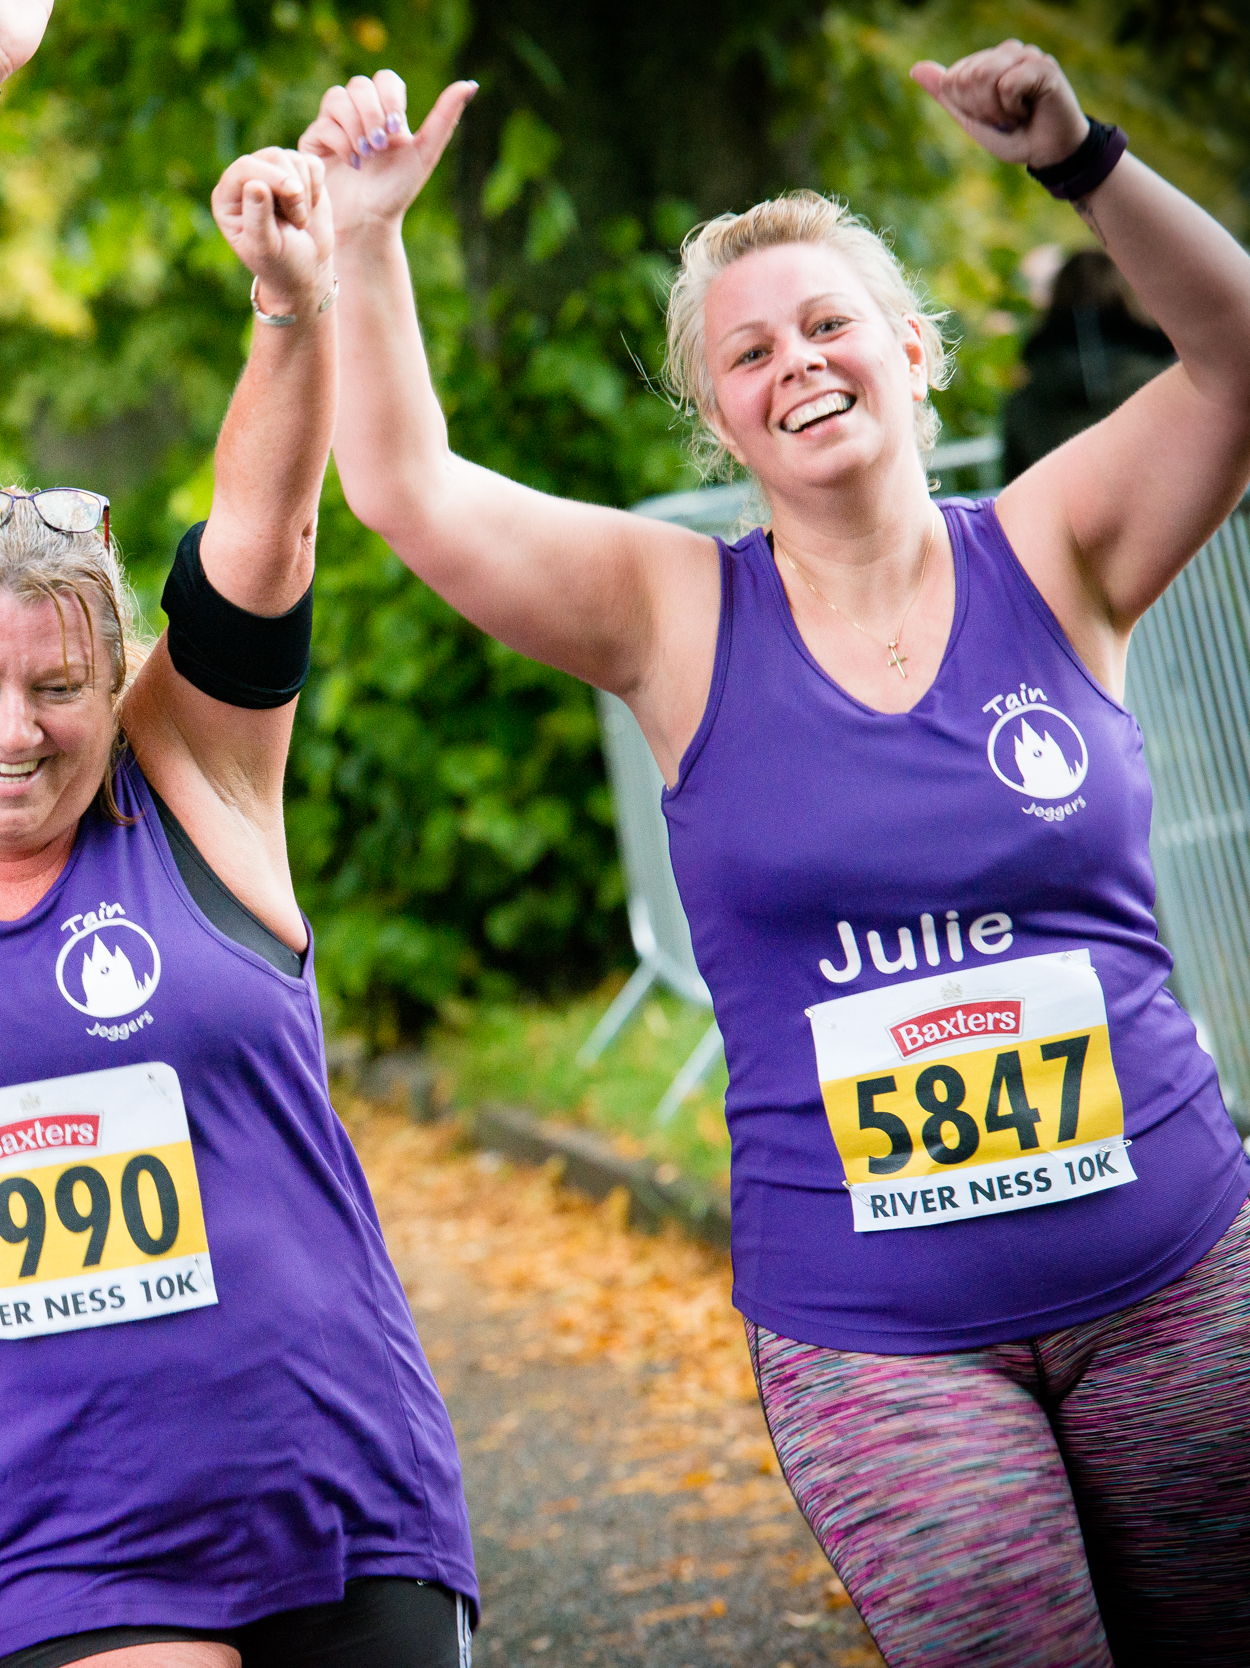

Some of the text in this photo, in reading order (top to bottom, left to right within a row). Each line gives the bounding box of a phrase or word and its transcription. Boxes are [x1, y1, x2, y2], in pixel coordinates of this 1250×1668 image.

[982, 683, 1048, 716] Tain
[1021, 795, 1086, 821] Joggers
[60, 901, 126, 934] Tain
[819, 910, 1014, 983] Julie
[86, 1010, 154, 1041] Joggers
[897, 1009, 1017, 1052] Baxters
[856, 1034, 1090, 1175] 5847
[870, 1151, 1119, 1219] RIVER NESS 10K
[44, 1285, 126, 1319] NESS
[140, 1270, 199, 1303] 10K
